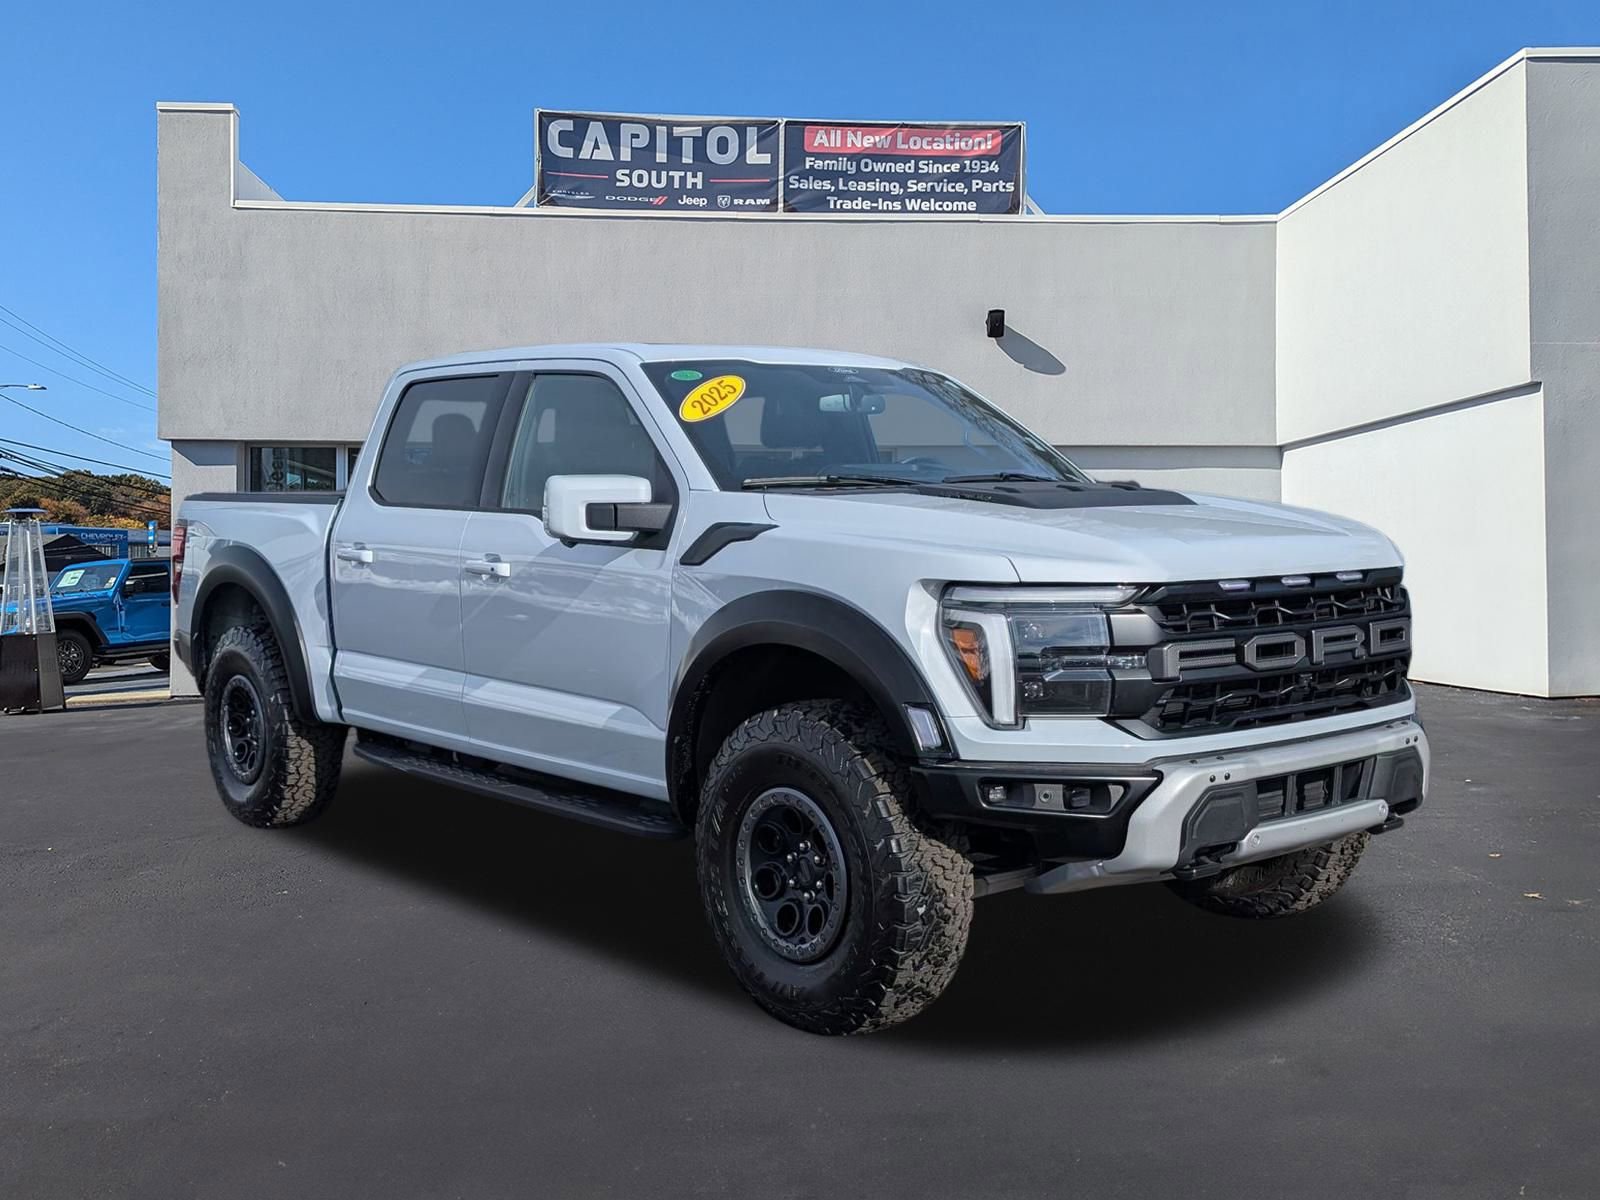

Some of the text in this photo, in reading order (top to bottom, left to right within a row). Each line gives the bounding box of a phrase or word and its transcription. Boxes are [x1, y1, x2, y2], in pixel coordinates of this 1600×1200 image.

[547, 119, 771, 164] CAPITOL
[813, 130, 993, 150] All New Location!
[805, 157, 1000, 174] Family Owned Since 1934
[615, 169, 703, 189] SOUTH
[789, 176, 1015, 195] Sales, Leasing, Service, Parts
[678, 195, 708, 207] Jeep
[826, 196, 977, 211] Trade-Ins Welcome
[691, 380, 737, 415] 2025
[1150, 617, 1411, 682] FORD
